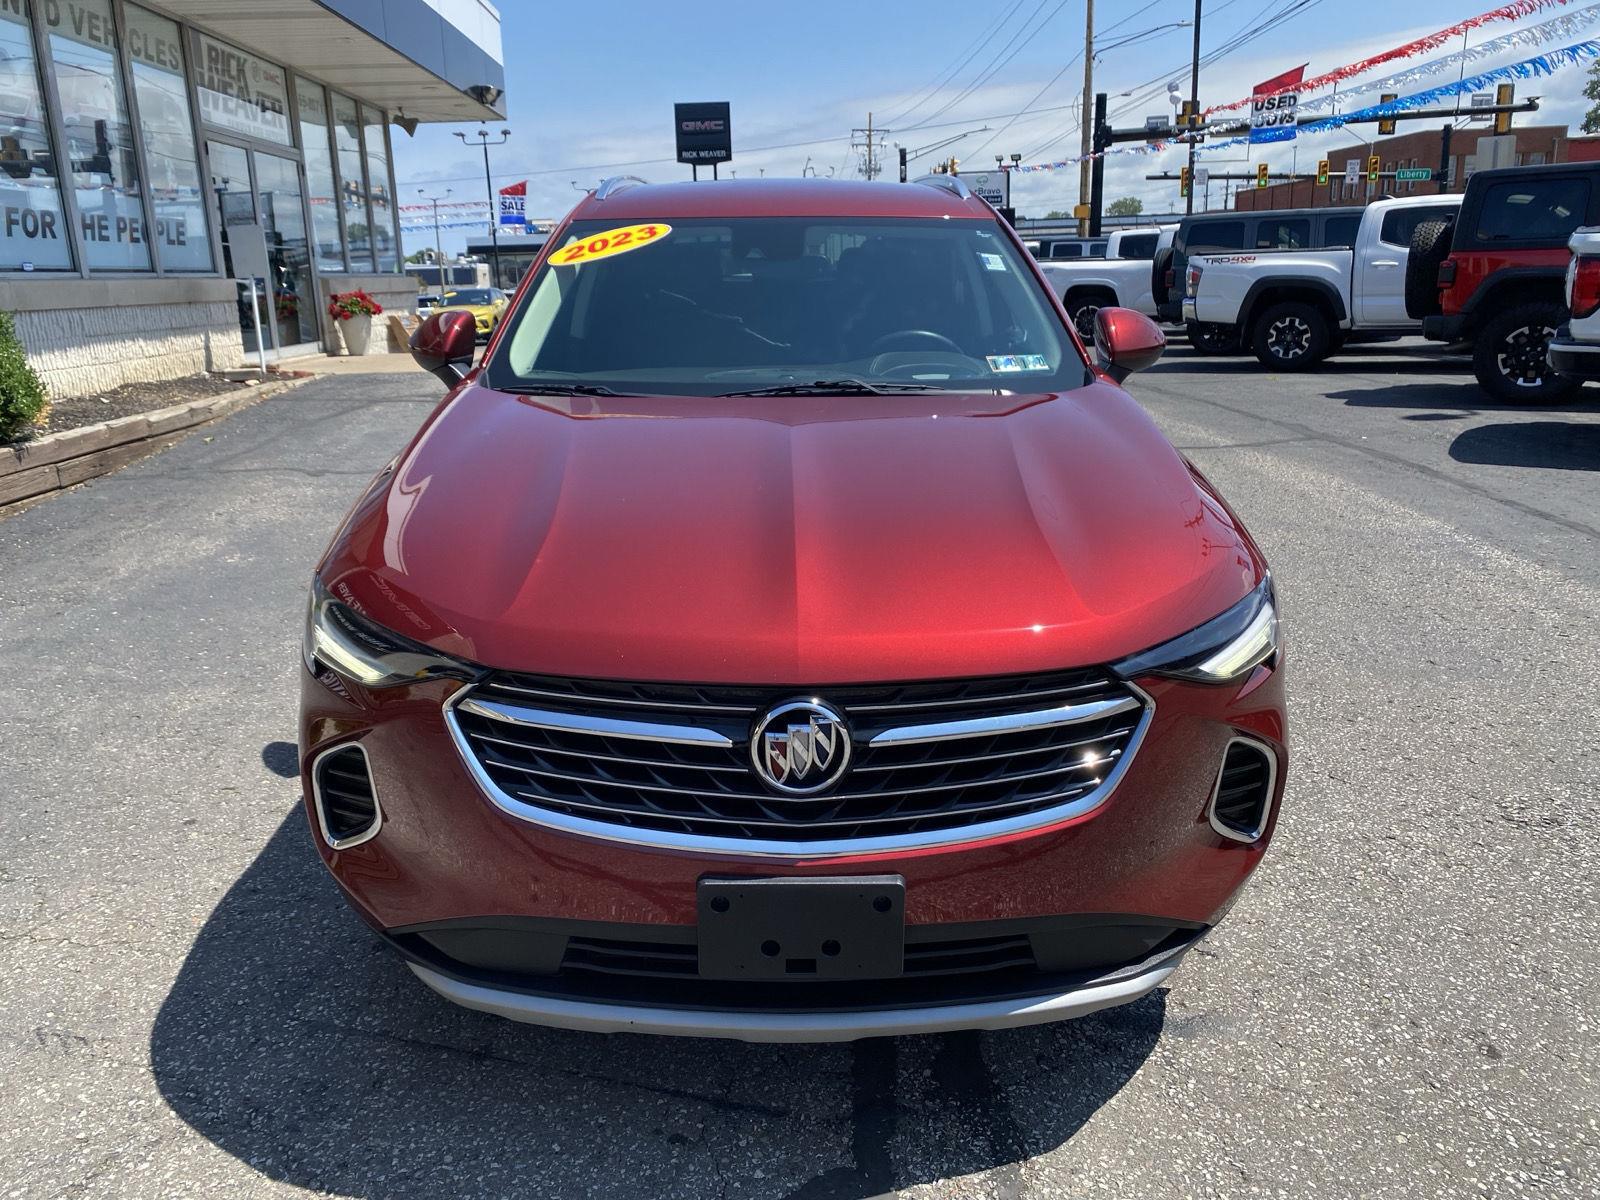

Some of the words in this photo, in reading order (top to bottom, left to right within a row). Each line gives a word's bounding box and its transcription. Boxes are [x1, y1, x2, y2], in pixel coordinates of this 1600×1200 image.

[68, 3, 179, 70] VEHCLES
[207, 43, 248, 80] RICK
[1254, 94, 1297, 111] USED
[681, 120, 724, 131] GMC
[699, 150, 726, 158] WEAVER
[1400, 170, 1427, 179] Liberty
[501, 201, 526, 211] SALE
[5, 206, 57, 239] FOR
[81, 213, 110, 242] HE
[116, 216, 186, 246] PEPLE
[563, 226, 658, 262] 2023
